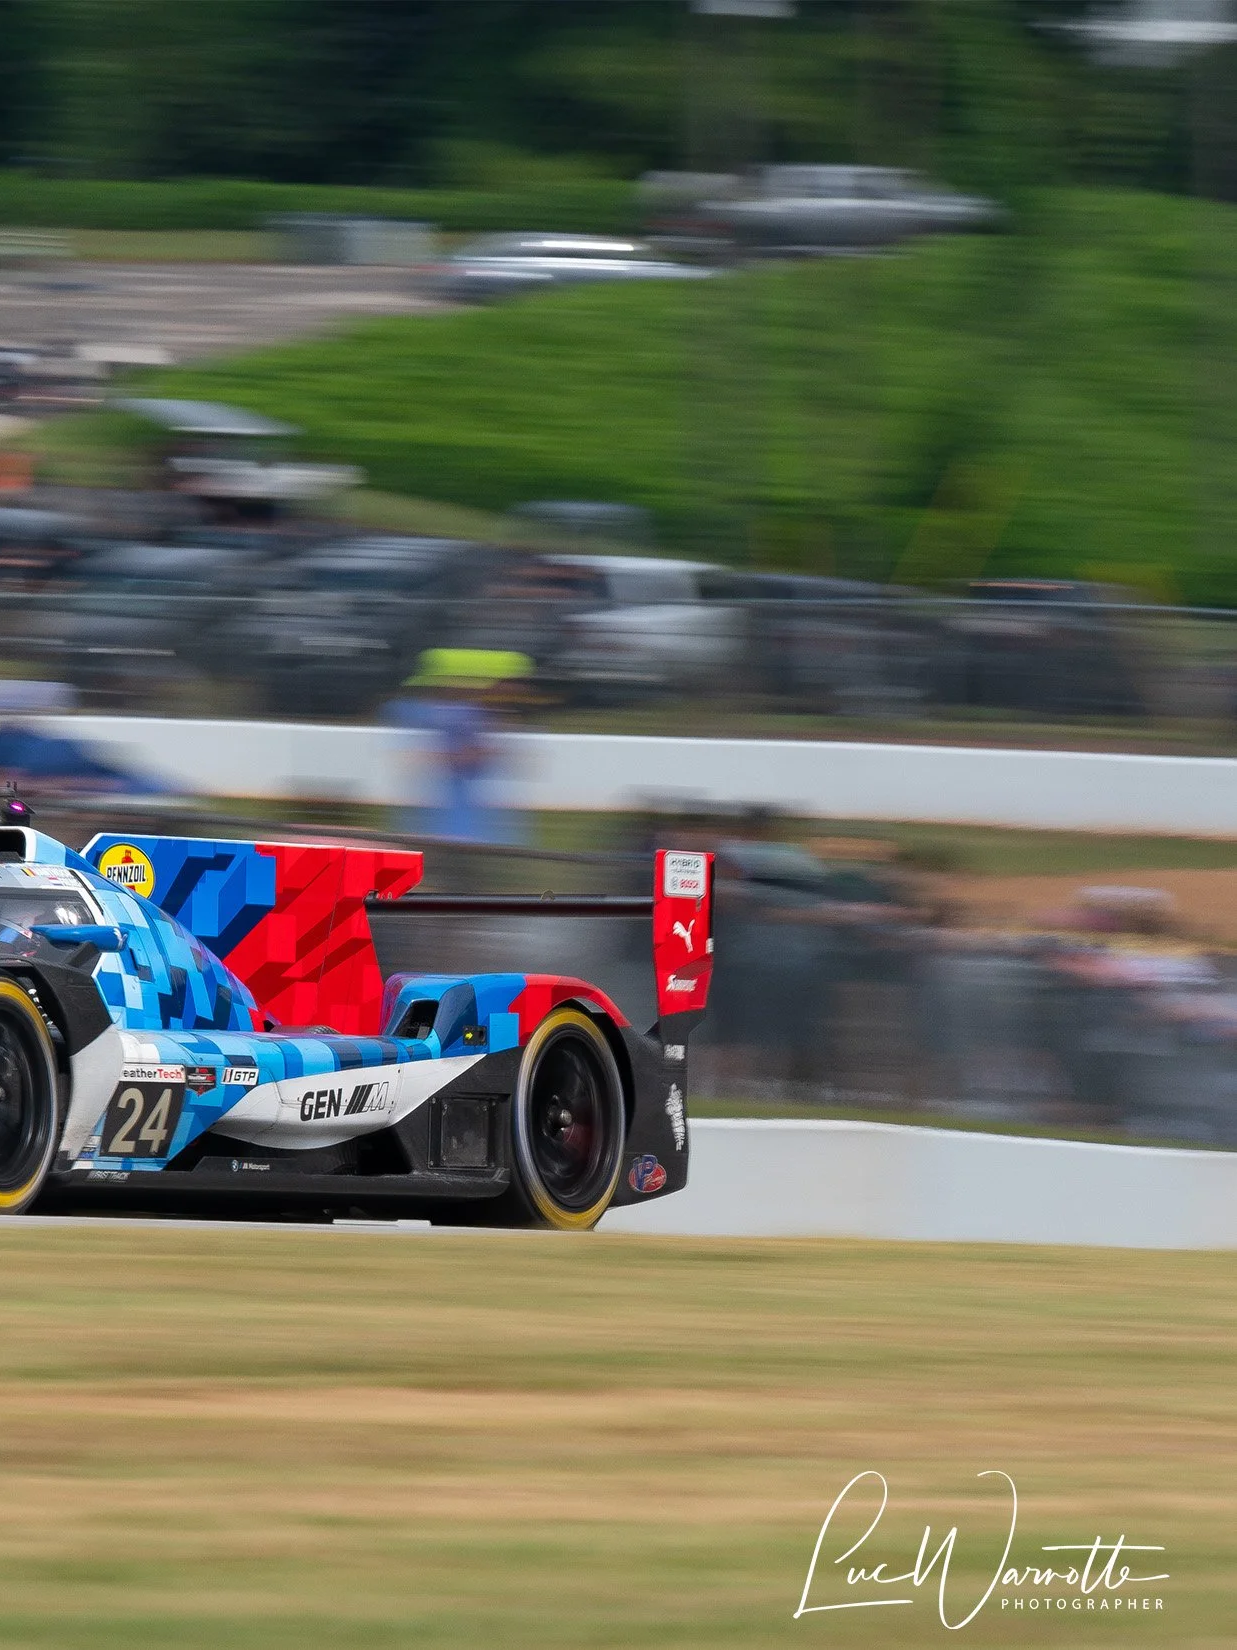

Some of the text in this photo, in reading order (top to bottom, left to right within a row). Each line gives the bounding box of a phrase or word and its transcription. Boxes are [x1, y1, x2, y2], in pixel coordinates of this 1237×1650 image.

[106, 864, 147, 884] PENNZOIL
[123, 1067, 183, 1080] eatherTech
[233, 1071, 257, 1082] GTP
[300, 1088, 343, 1122] GEN
[108, 1087, 173, 1154] 24
